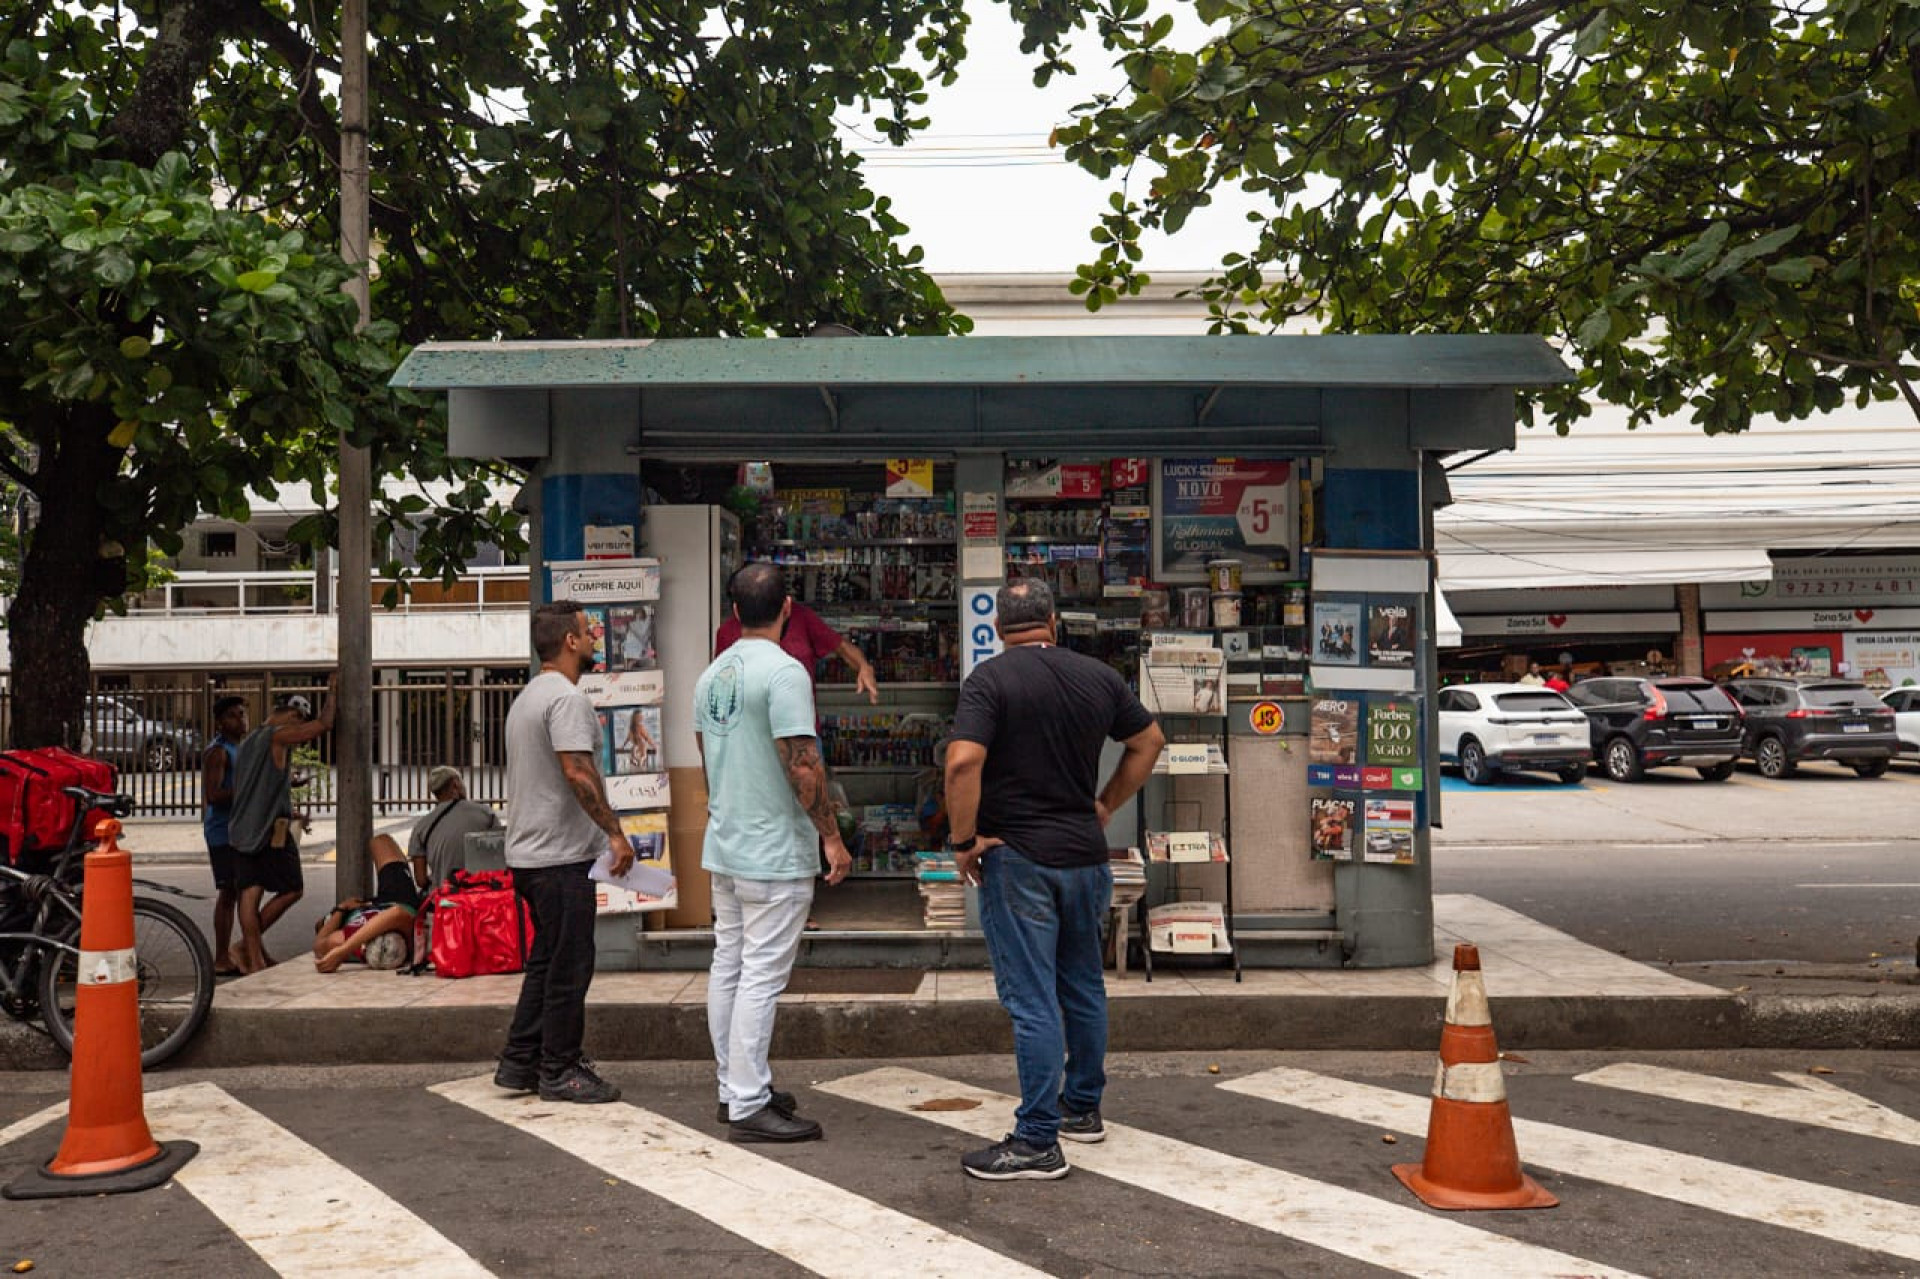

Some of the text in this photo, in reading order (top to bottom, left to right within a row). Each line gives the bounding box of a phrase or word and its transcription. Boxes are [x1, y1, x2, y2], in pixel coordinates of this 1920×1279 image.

[1127, 458, 1138, 483] 5
[1163, 464, 1198, 476] LUCKY
[1178, 481, 1222, 496] NOVO
[1173, 540, 1225, 551] GLOBAL
[571, 579, 642, 592] COMPRE AQUI
[1506, 618, 1546, 628] Zona Sul
[1813, 612, 1853, 622] Zona Sul
[1313, 700, 1348, 712] AERO
[1259, 710, 1275, 727] 18
[1373, 708, 1411, 720] Forbes
[1373, 723, 1411, 740] 100
[1372, 743, 1411, 756] AGRO
